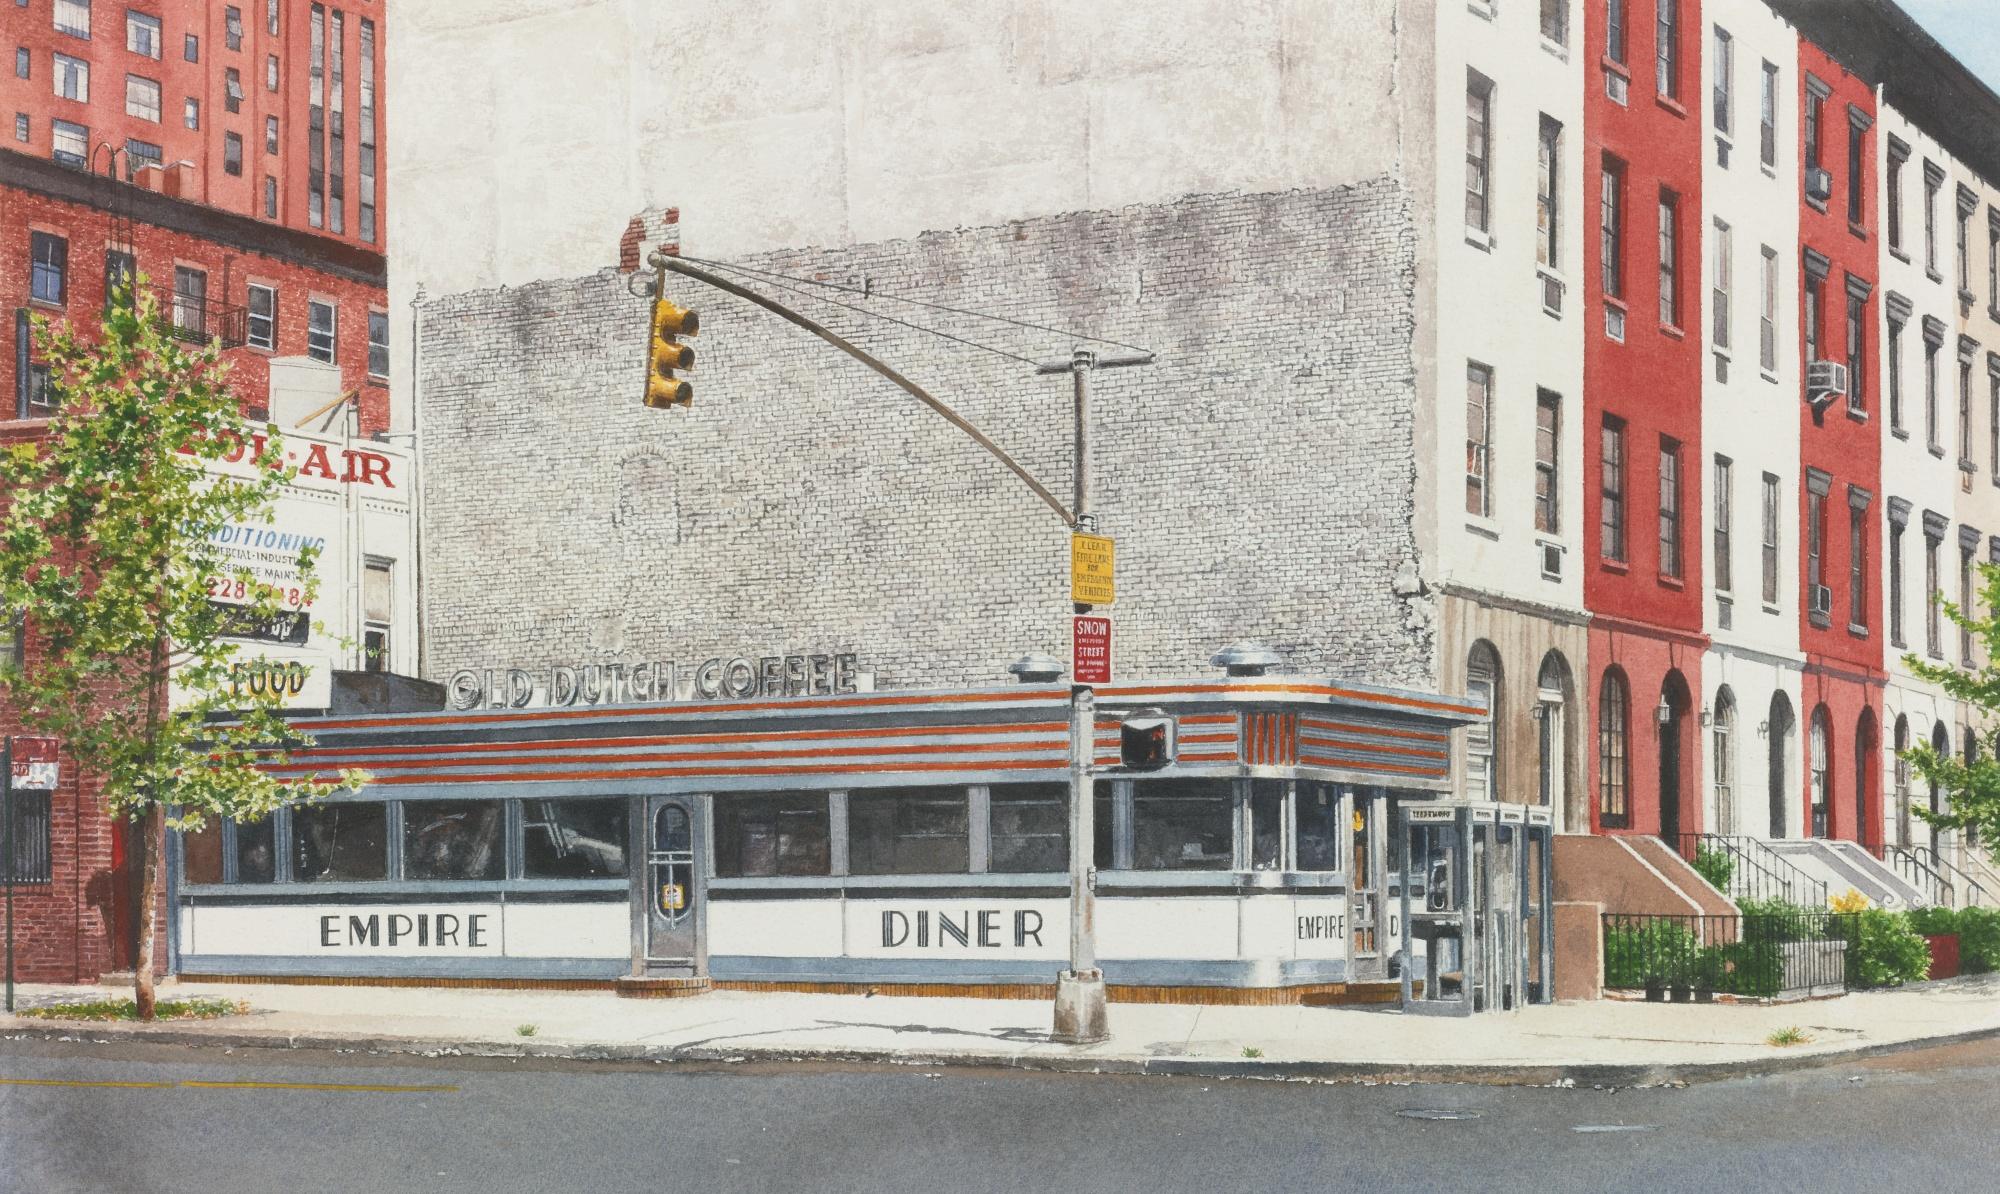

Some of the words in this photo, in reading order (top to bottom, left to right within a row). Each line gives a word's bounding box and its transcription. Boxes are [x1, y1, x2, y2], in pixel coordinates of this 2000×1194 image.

[1077, 620, 1107, 636] SNOW
[1078, 647, 1105, 657] STREET
[229, 661, 304, 698] FOOD
[449, 669, 533, 711] OLD
[550, 661, 675, 706] DUTCH
[695, 653, 857, 699] COFFEE
[320, 913, 488, 947] EMPIRE
[882, 909, 1043, 948] DINER
[1297, 915, 1344, 940] EMPIRE
